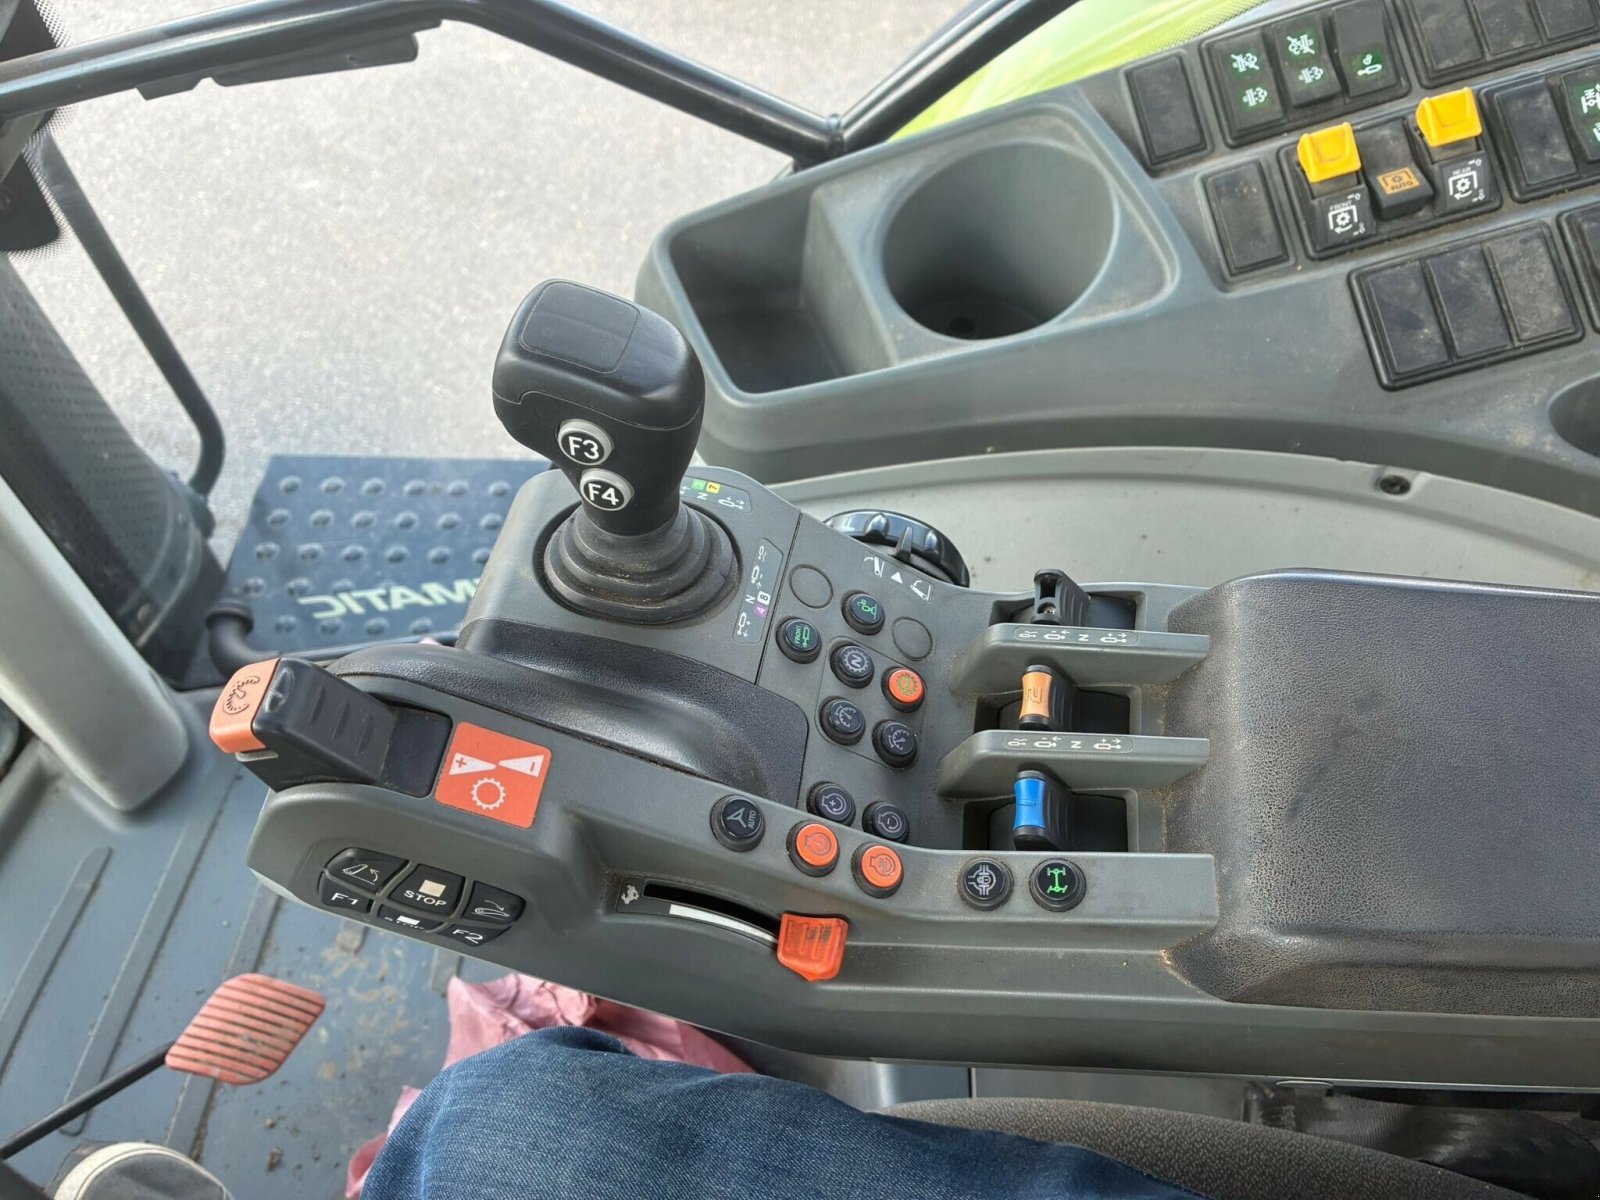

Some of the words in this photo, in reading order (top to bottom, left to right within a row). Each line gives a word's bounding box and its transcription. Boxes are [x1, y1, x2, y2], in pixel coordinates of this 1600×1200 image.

[1390, 180, 1414, 191] AUTO
[568, 435, 600, 460] F3
[588, 482, 620, 506] F4
[696, 492, 709, 500] N
[745, 594, 756, 605] N
[1078, 633, 1089, 642] N
[1070, 740, 1082, 749] N
[750, 809, 758, 830] AUTO
[330, 892, 359, 906] F1
[403, 889, 447, 907] STOP
[452, 929, 484, 945] F2
